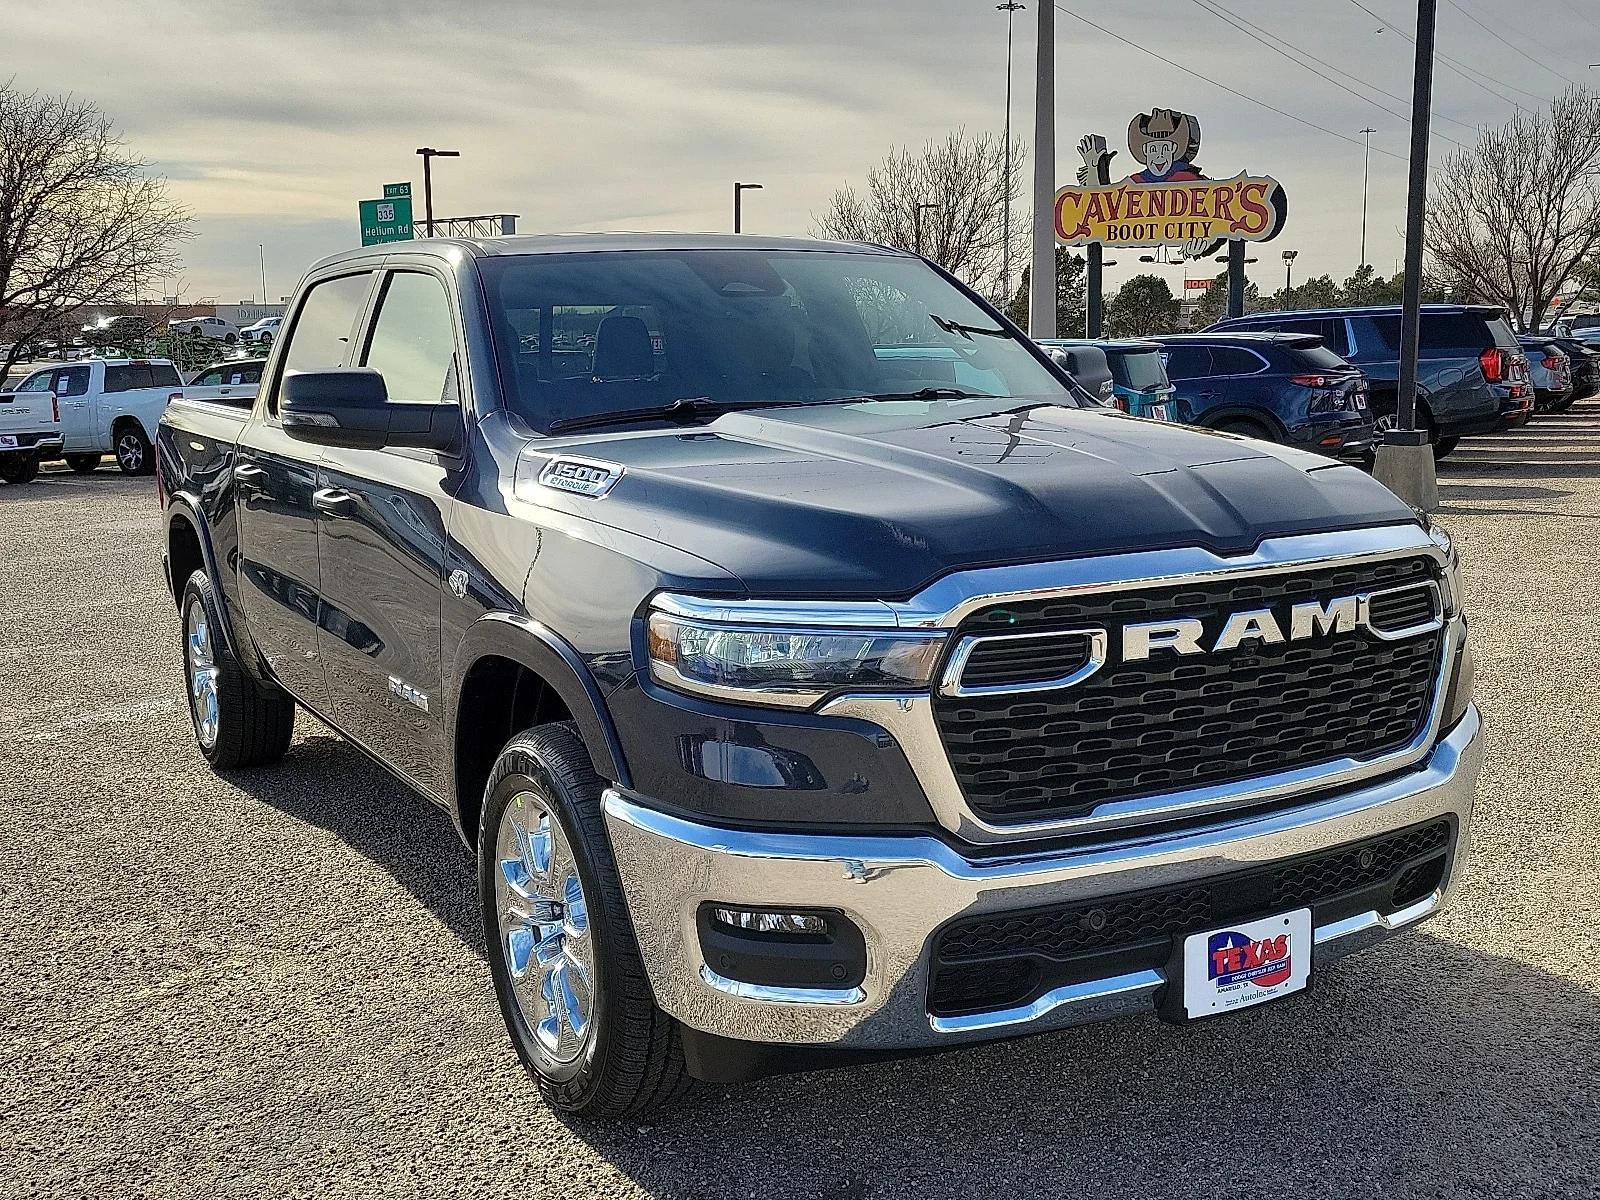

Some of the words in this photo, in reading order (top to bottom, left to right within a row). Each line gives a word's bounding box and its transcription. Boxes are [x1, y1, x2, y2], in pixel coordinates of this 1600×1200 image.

[386, 187, 397, 195] EXIT
[399, 185, 409, 195] 63
[378, 210, 394, 220] 335
[1055, 182, 1269, 239] CAVENDER'S
[365, 226, 395, 237] Helium
[397, 224, 409, 235] Rd
[1106, 224, 1159, 242] BOOT
[1164, 221, 1214, 239] CITY
[554, 463, 609, 483] 1500
[1122, 595, 1357, 662] RAM
[1212, 934, 1288, 975] TEXAS
